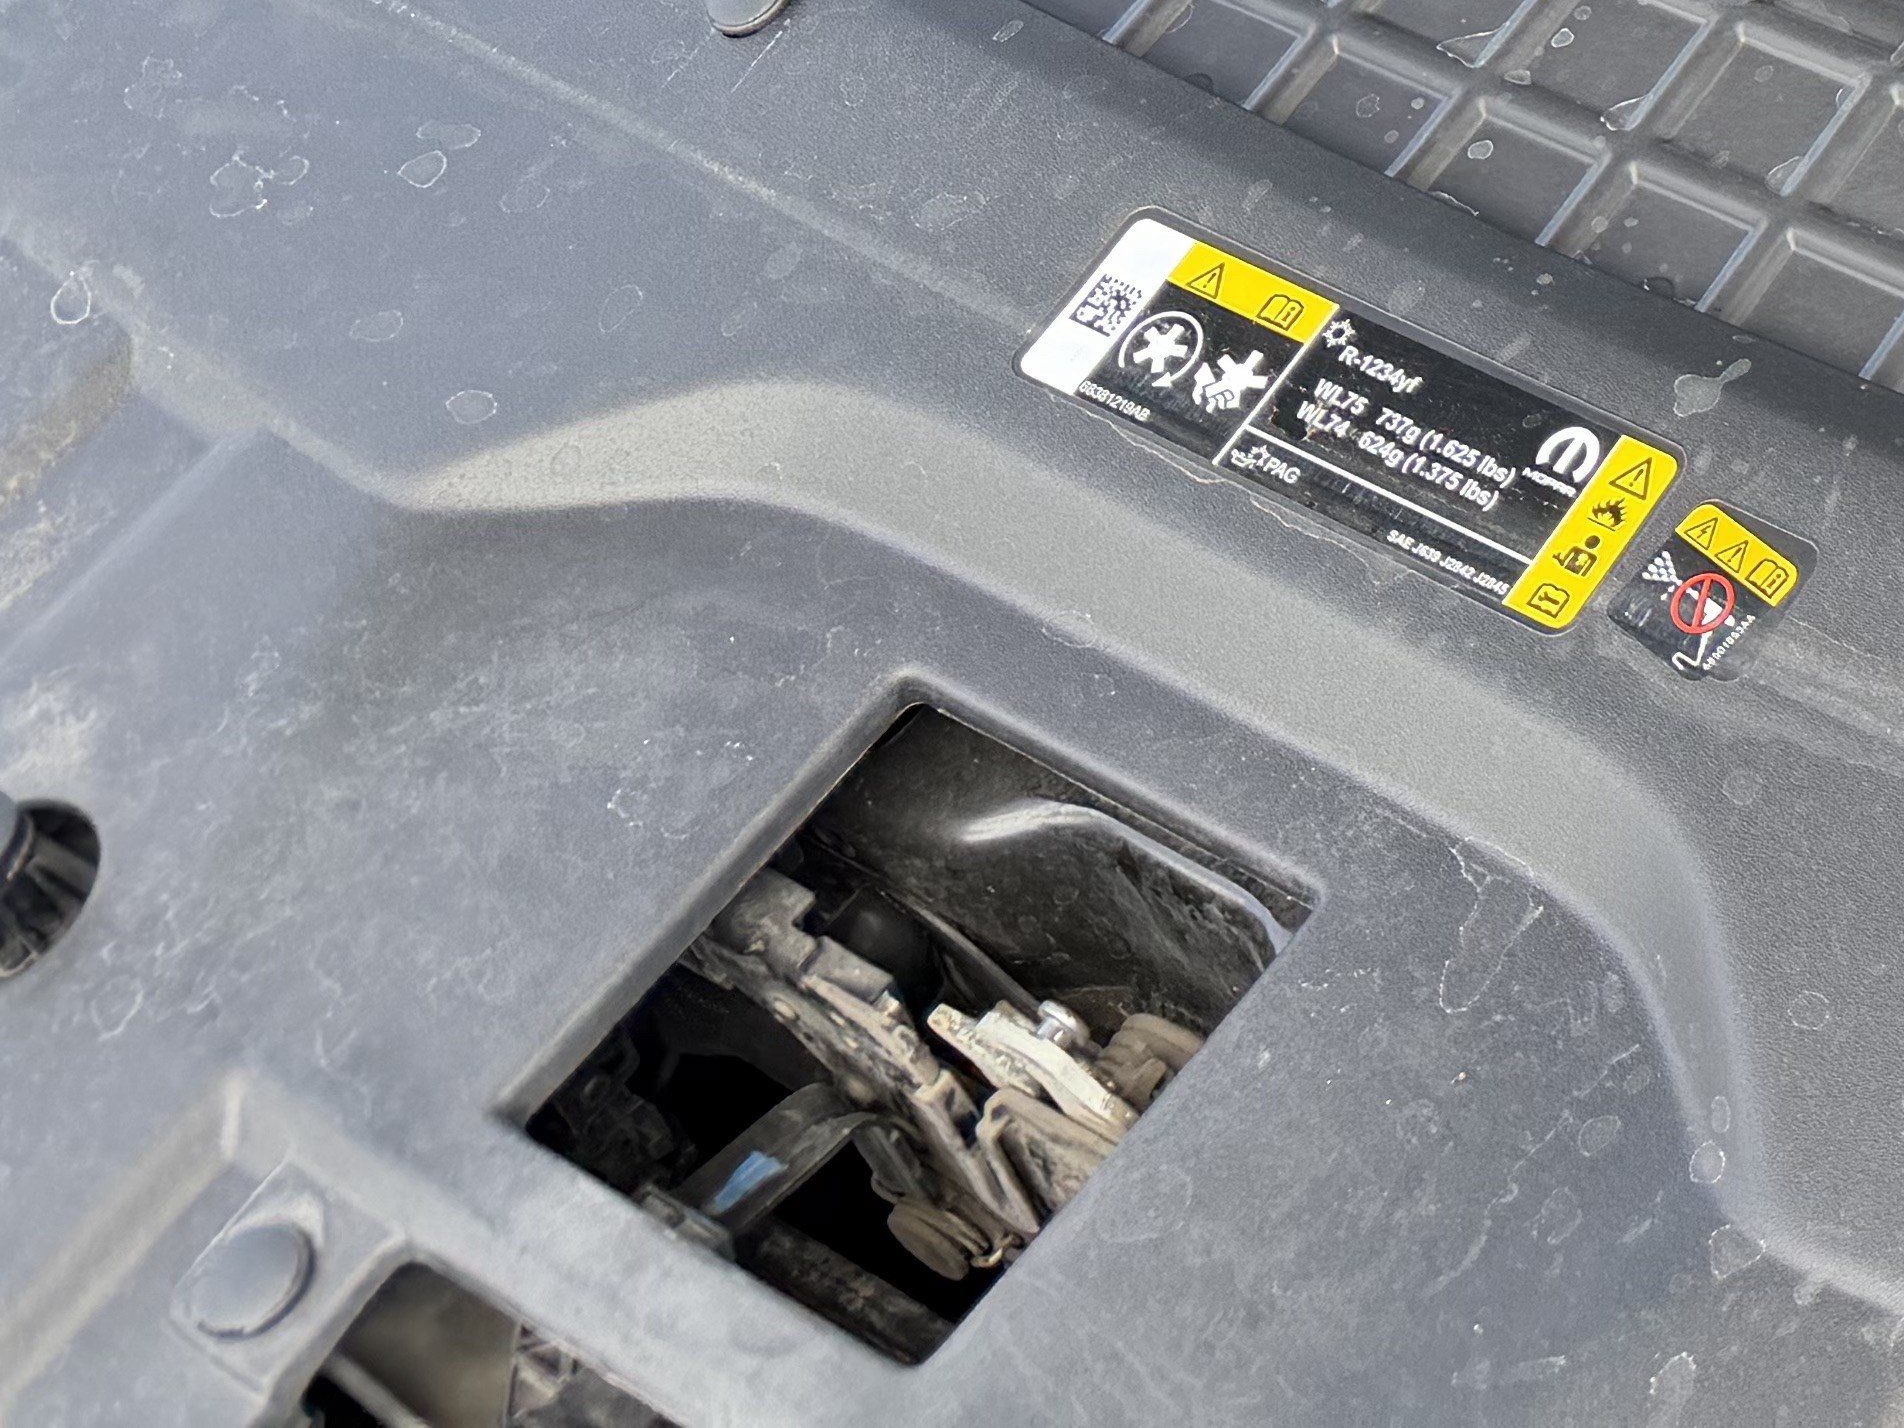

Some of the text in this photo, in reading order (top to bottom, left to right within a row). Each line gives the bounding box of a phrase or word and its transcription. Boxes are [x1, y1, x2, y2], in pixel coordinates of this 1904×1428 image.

[1338, 345, 1424, 393] R-1234yf
[1296, 400, 1499, 512] WL74 624g (1.375 lbs)
[1314, 378, 1516, 489] WL75 737g (1.625 lbs)
[1262, 456, 1301, 484] PAG
[1386, 529, 1510, 595] SAE J639 J2842 J2845
